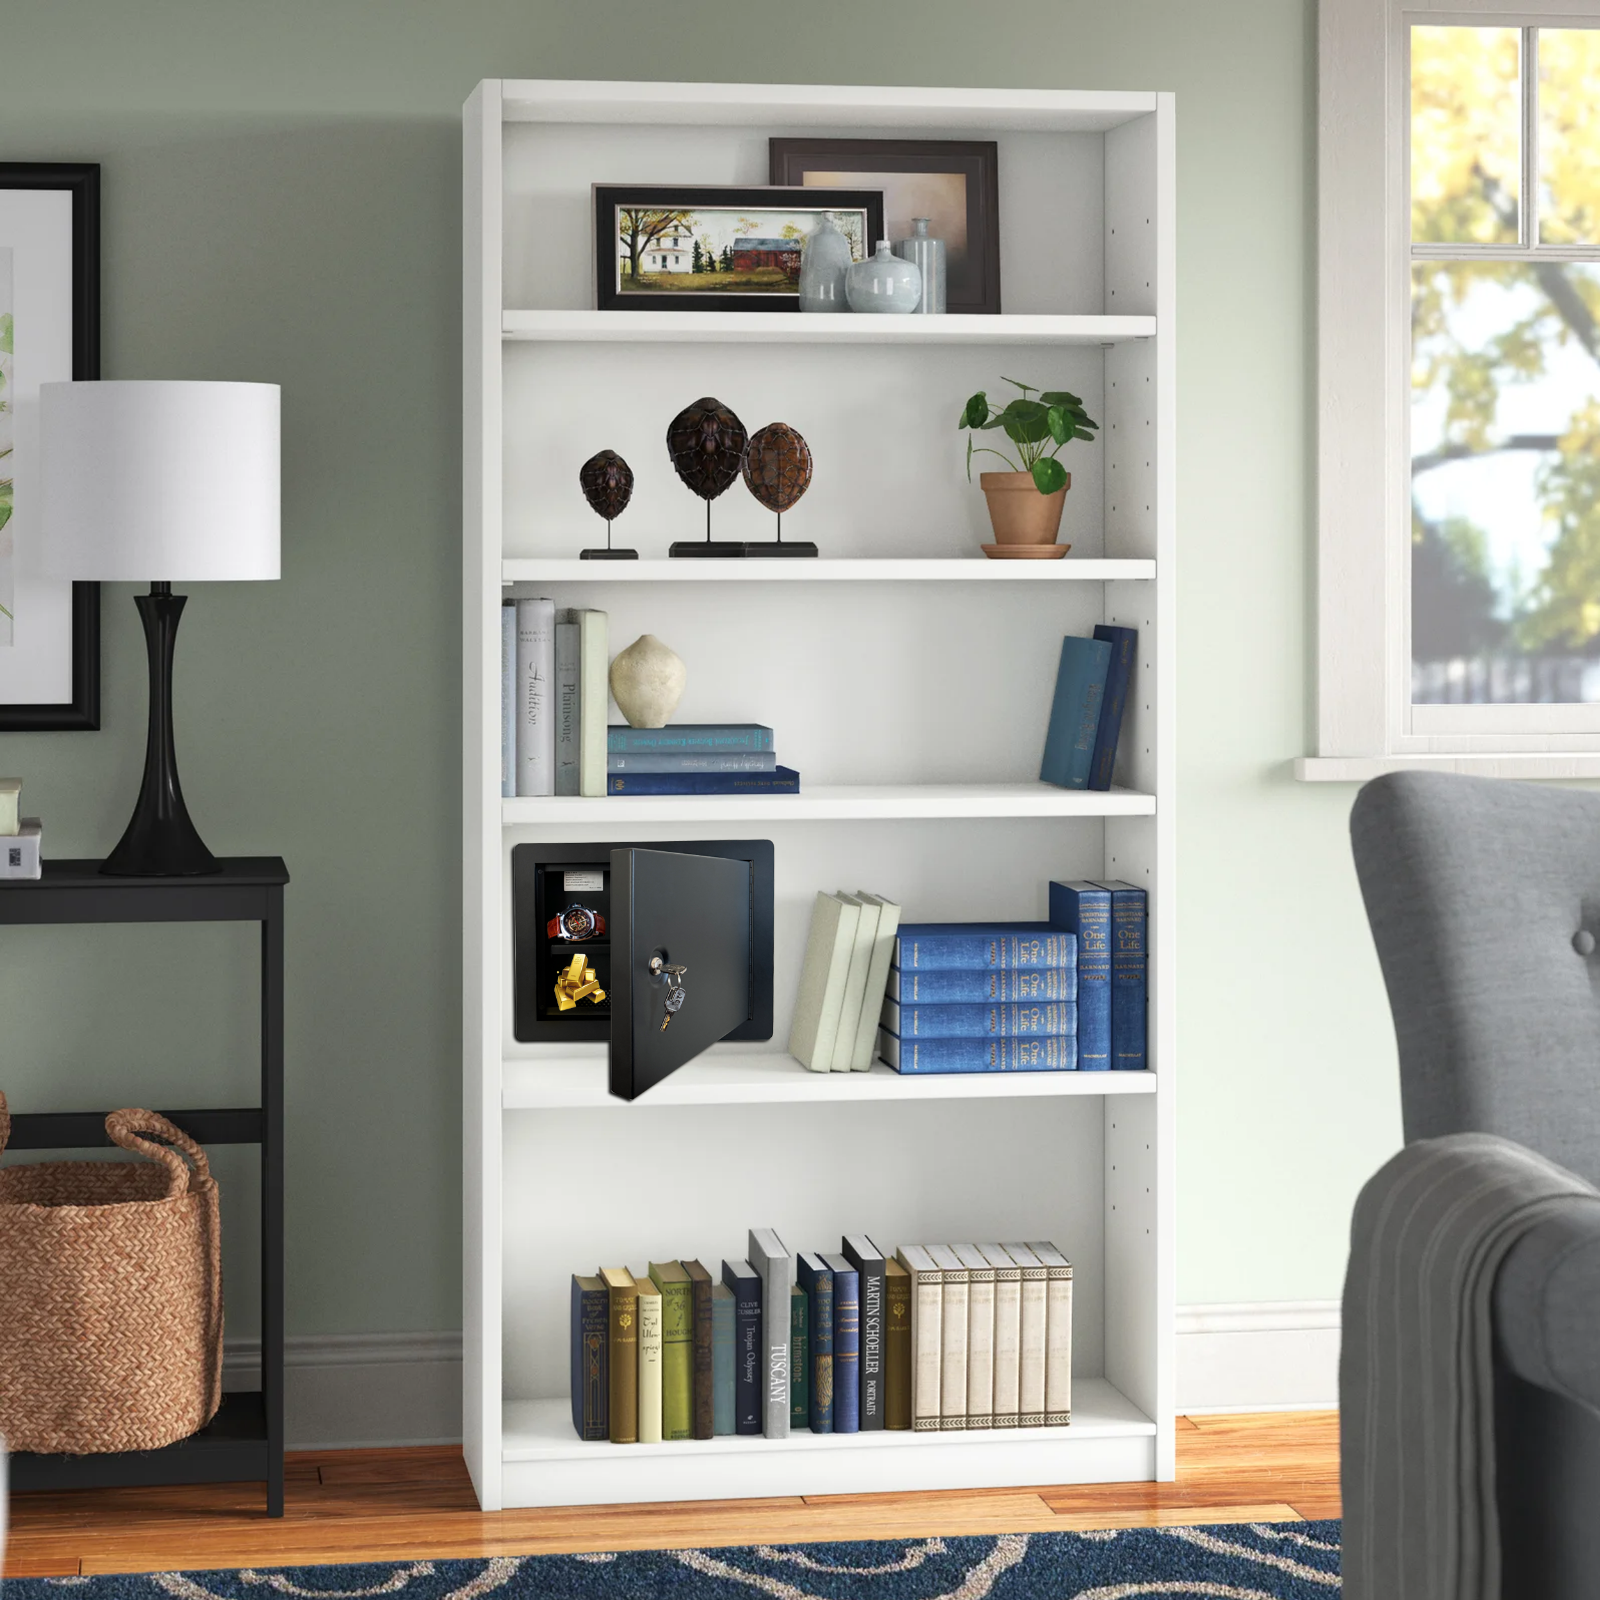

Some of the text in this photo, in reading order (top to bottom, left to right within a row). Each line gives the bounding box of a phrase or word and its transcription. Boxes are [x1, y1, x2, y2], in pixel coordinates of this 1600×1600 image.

[527, 661, 546, 726] Audition
[560, 683, 576, 743] Plainsong
[1083, 930, 1106, 940] One
[1085, 940, 1106, 950] Life
[1118, 930, 1140, 939] One
[1120, 940, 1140, 949] Life
[1020, 942, 1030, 964] Life
[1031, 940, 1040, 964] One
[1020, 975, 1030, 997] Life
[1031, 973, 1040, 997] One
[1020, 1010, 1030, 1031] Life
[1031, 1008, 1040, 1031] One
[1020, 1043, 1030, 1065] Life
[1031, 1041, 1040, 1065] One
[743, 1326, 756, 1384] Trojan Odyssey
[866, 1276, 880, 1416] MARTIN SCHOELLER PORTRAITS
[793, 1336, 806, 1383] brimstone
[770, 1343, 787, 1404] TUSCANY
